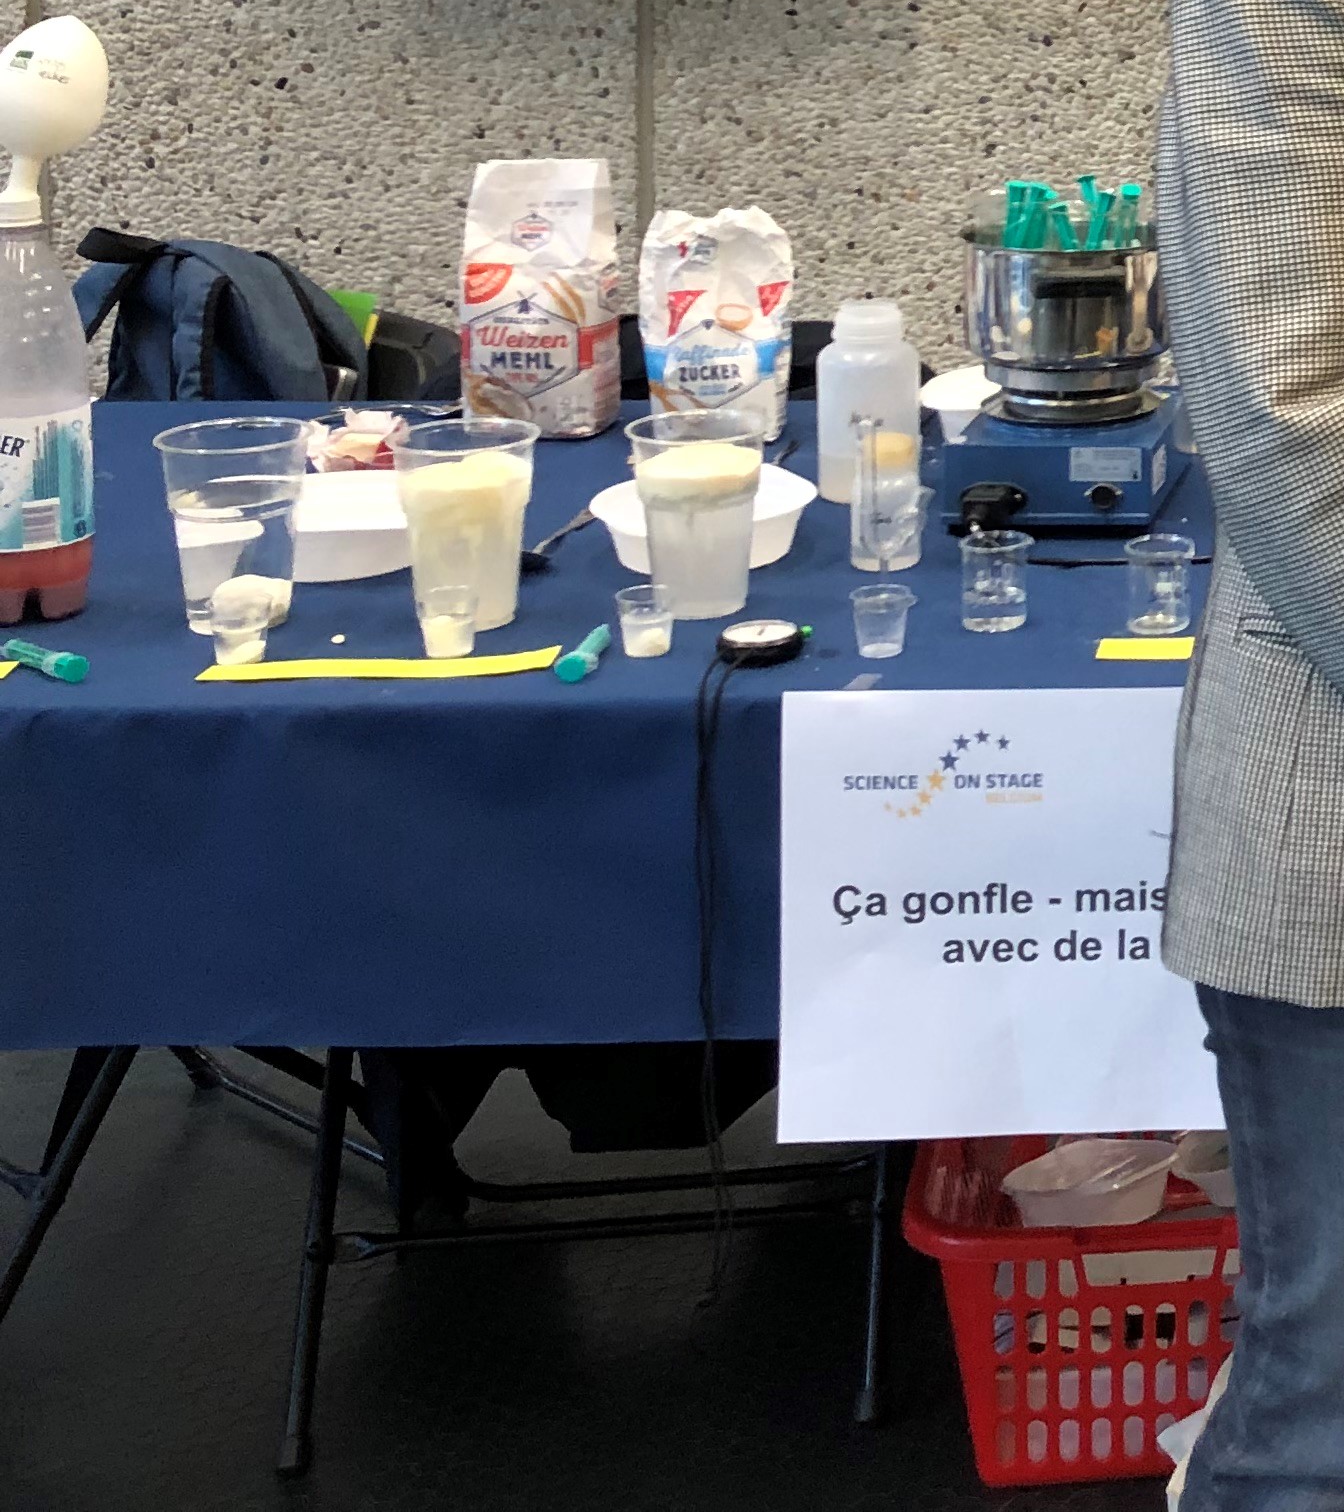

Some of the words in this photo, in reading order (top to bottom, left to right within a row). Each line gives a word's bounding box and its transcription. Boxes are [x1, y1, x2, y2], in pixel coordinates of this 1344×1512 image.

[476, 325, 568, 350] Weizen
[490, 351, 555, 370] MEHL
[679, 363, 741, 383] ZUCKER
[843, 774, 919, 791] SCIENCE
[953, 773, 981, 790] ON
[985, 772, 1044, 789] STAGE
[833, 884, 887, 925] Ça
[902, 882, 1033, 924] gonfle
[1048, 897, 1062, 905] -
[1075, 880, 1168, 912] mais
[943, 937, 1039, 964] avec
[1054, 929, 1101, 962] de
[1118, 929, 1150, 961] la
